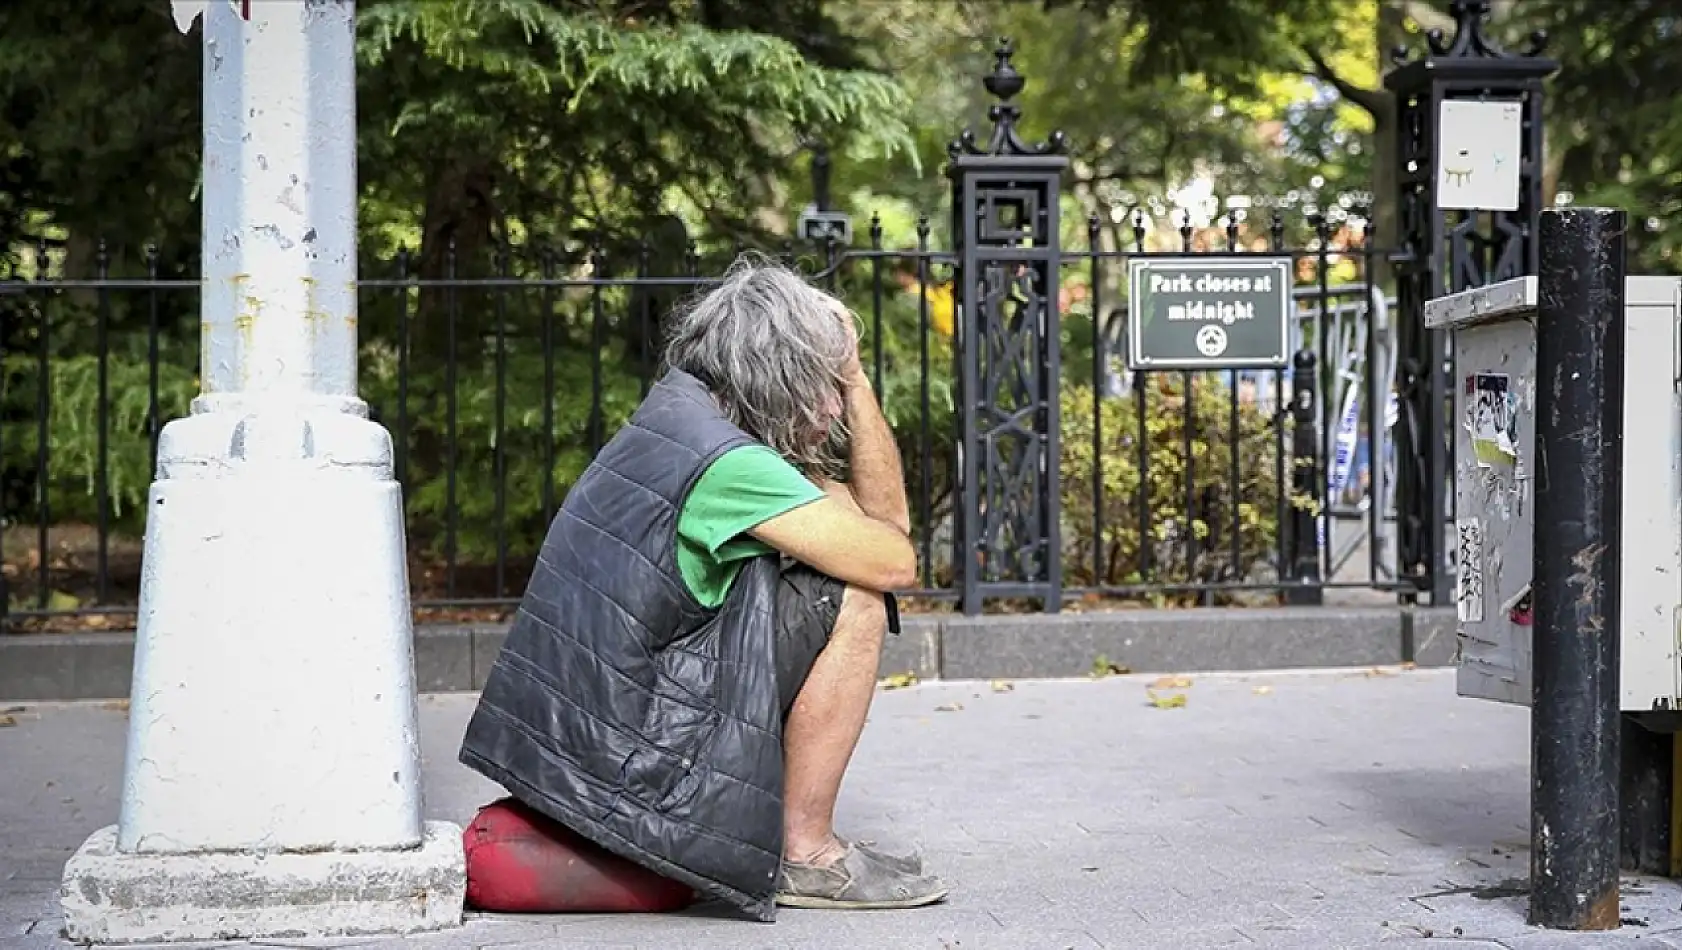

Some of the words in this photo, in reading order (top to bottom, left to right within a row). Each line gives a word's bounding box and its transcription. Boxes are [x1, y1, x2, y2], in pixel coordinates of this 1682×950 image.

[1151, 273, 1193, 293] Park
[1195, 272, 1251, 293] closes
[1253, 274, 1273, 293] at
[1168, 300, 1255, 325] midnight
